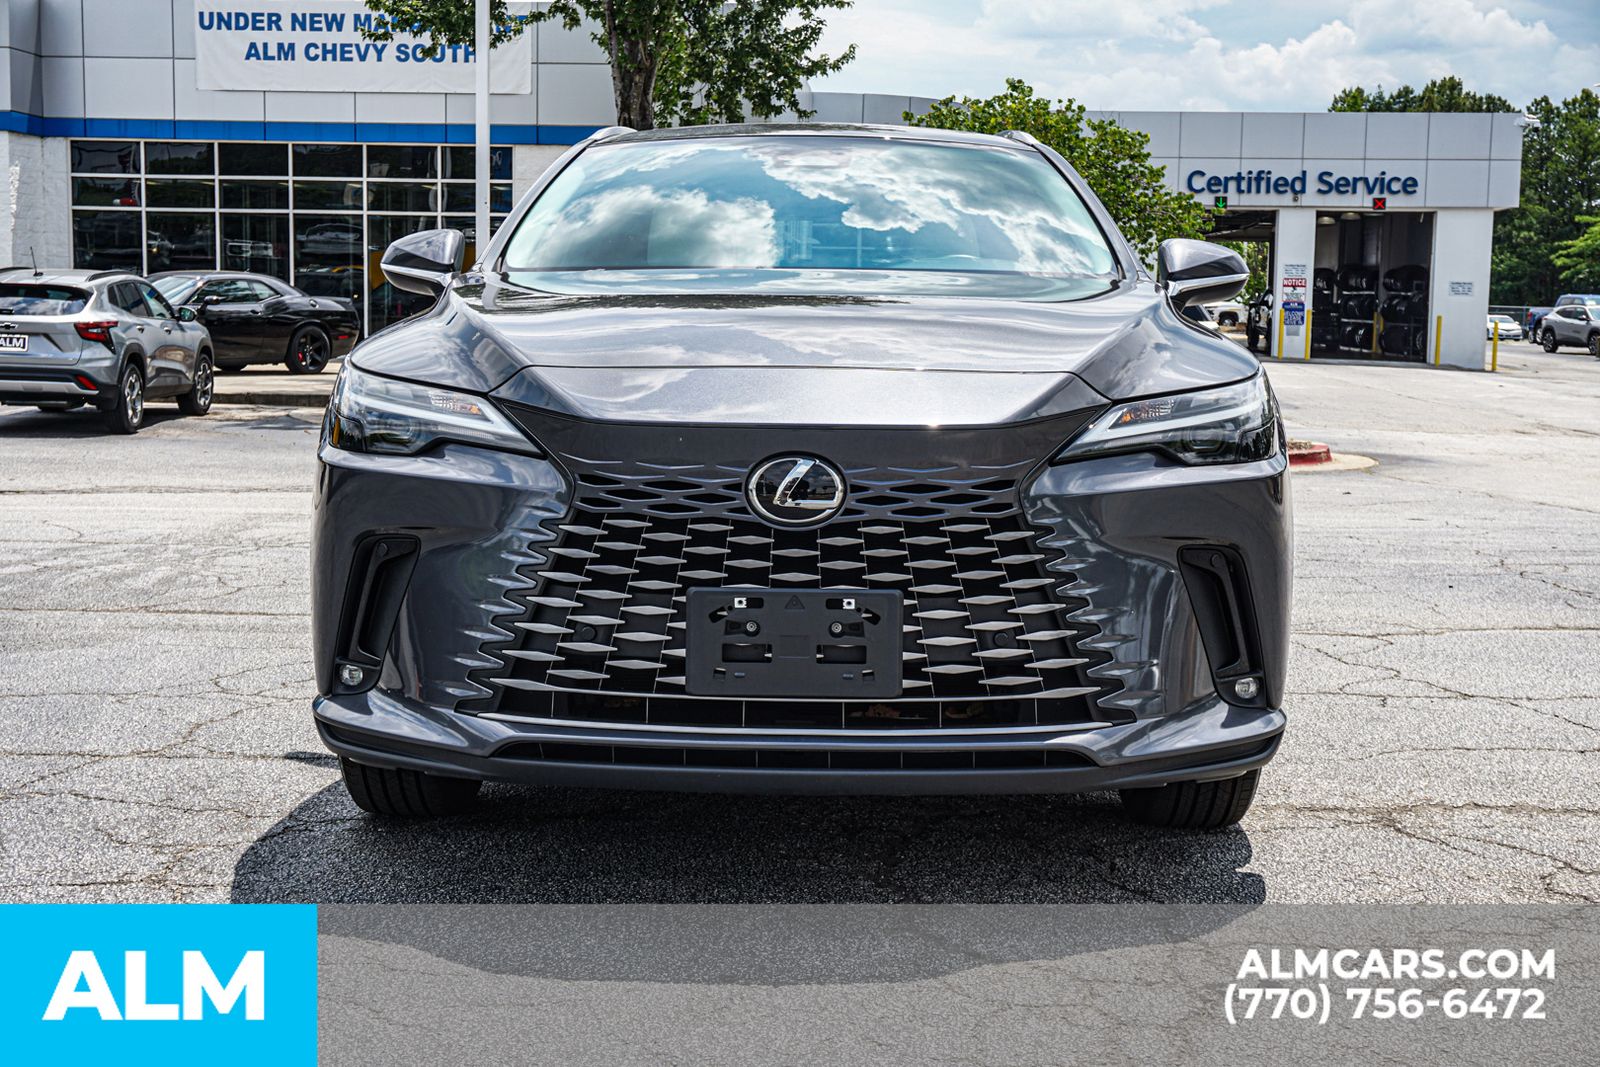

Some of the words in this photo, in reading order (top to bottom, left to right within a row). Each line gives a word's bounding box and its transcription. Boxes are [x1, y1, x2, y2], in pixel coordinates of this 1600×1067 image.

[199, 11, 283, 32] UNDER
[291, 12, 346, 33] NEW
[244, 42, 296, 62] ALM
[304, 42, 388, 63] CHEVY
[395, 43, 477, 64] SOUTH
[1187, 170, 1307, 195] Certified
[1317, 171, 1419, 196] Service
[1283, 279, 1307, 287] NOTICE
